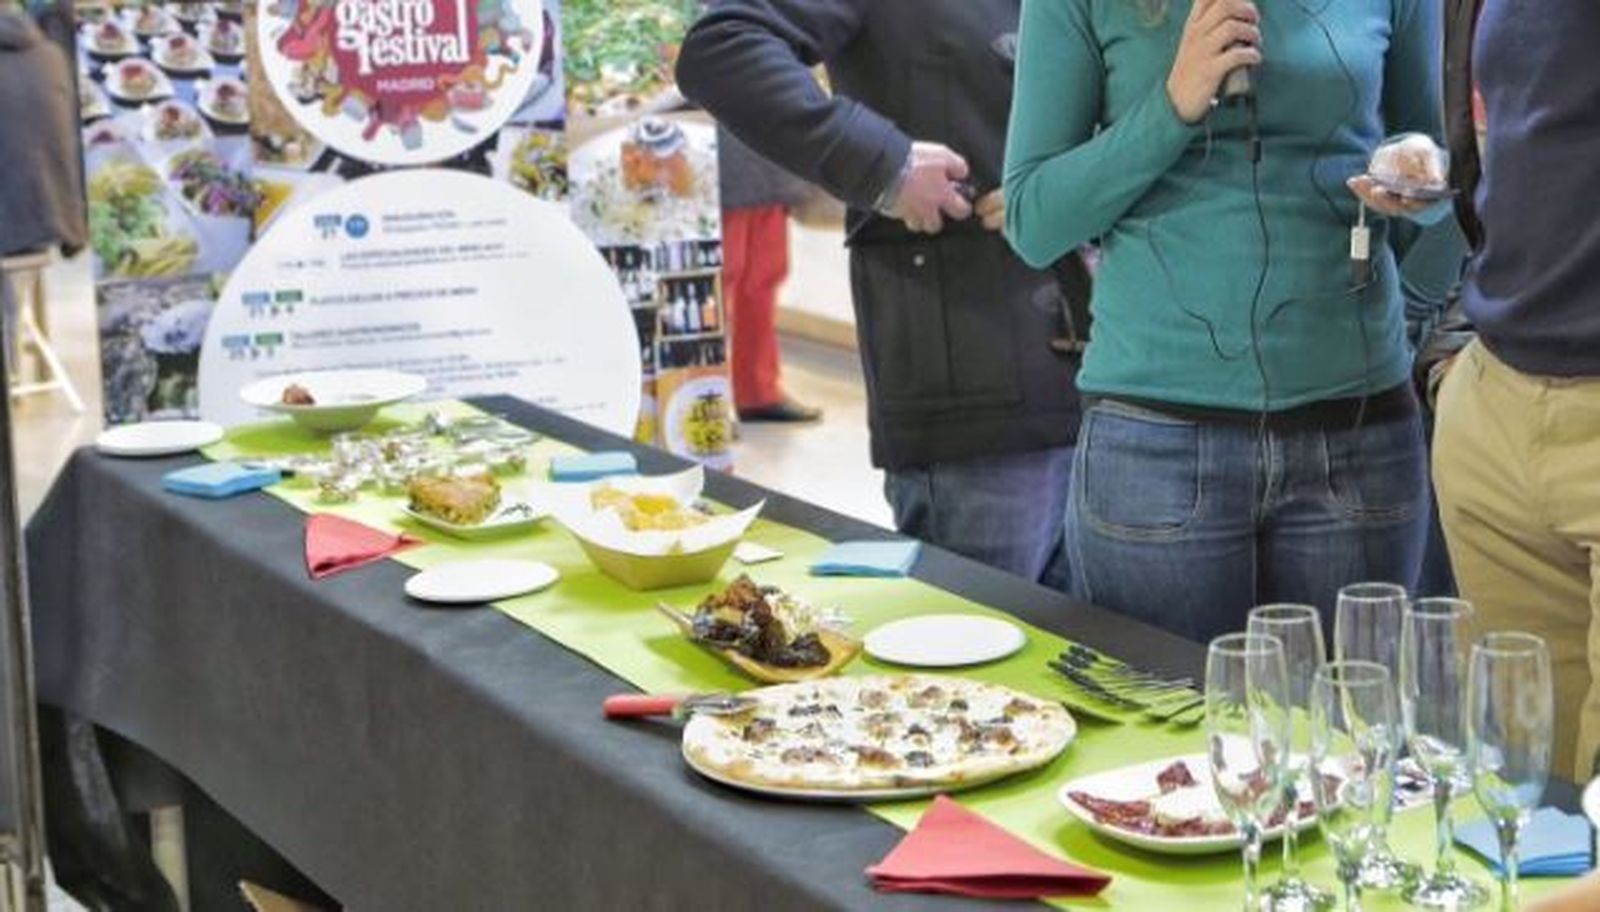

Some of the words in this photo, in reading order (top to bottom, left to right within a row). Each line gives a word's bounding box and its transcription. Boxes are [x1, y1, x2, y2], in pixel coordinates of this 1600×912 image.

[336, 0, 435, 49] gastro
[357, 0, 470, 75] festival
[376, 78, 434, 92] MADRID
